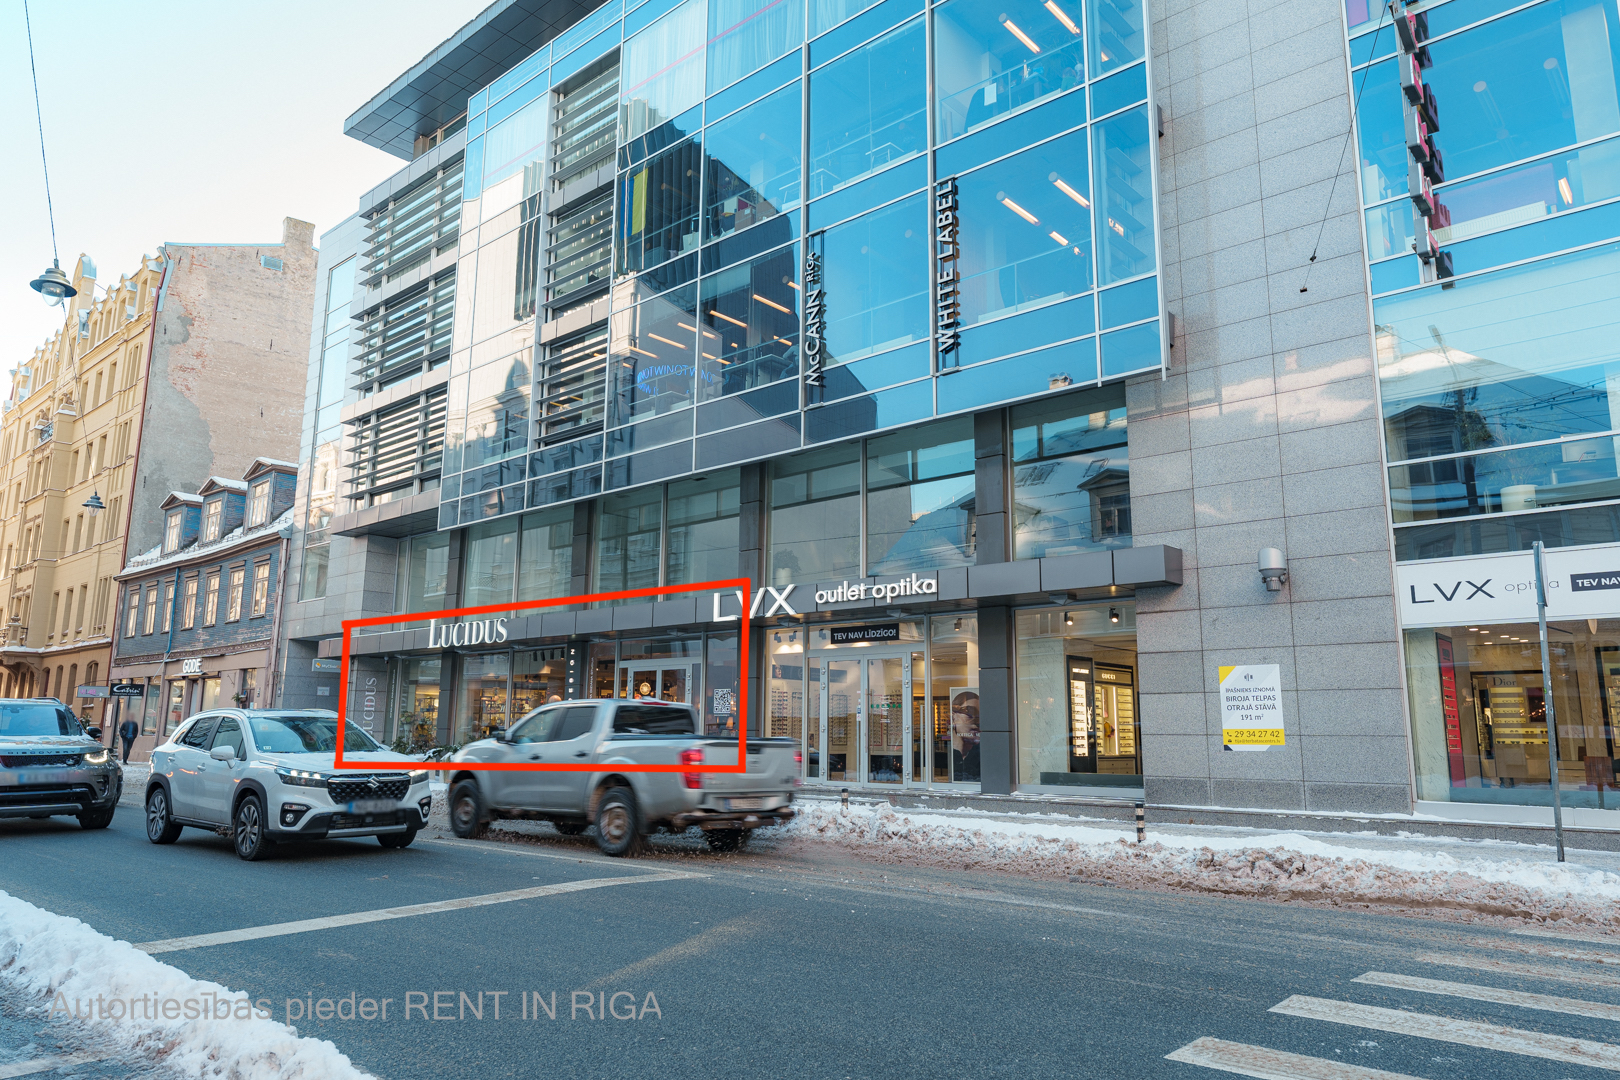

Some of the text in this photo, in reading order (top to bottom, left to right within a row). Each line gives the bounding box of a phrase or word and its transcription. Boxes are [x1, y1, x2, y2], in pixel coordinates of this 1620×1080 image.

[936, 180, 955, 353] WHITE LABEL
[815, 572, 938, 605] outlet optika
[1410, 578, 1560, 604] LVX optia
[1576, 578, 1599, 588] TEV
[713, 584, 798, 622] LVX
[427, 617, 508, 649] LUCIDUS
[833, 628, 897, 641] TEV NAV LĪDZĪGO!
[1492, 676, 1517, 687] Dior
[362, 677, 377, 734] UCIDUS
[1234, 730, 1280, 738] 29 34 27 42
